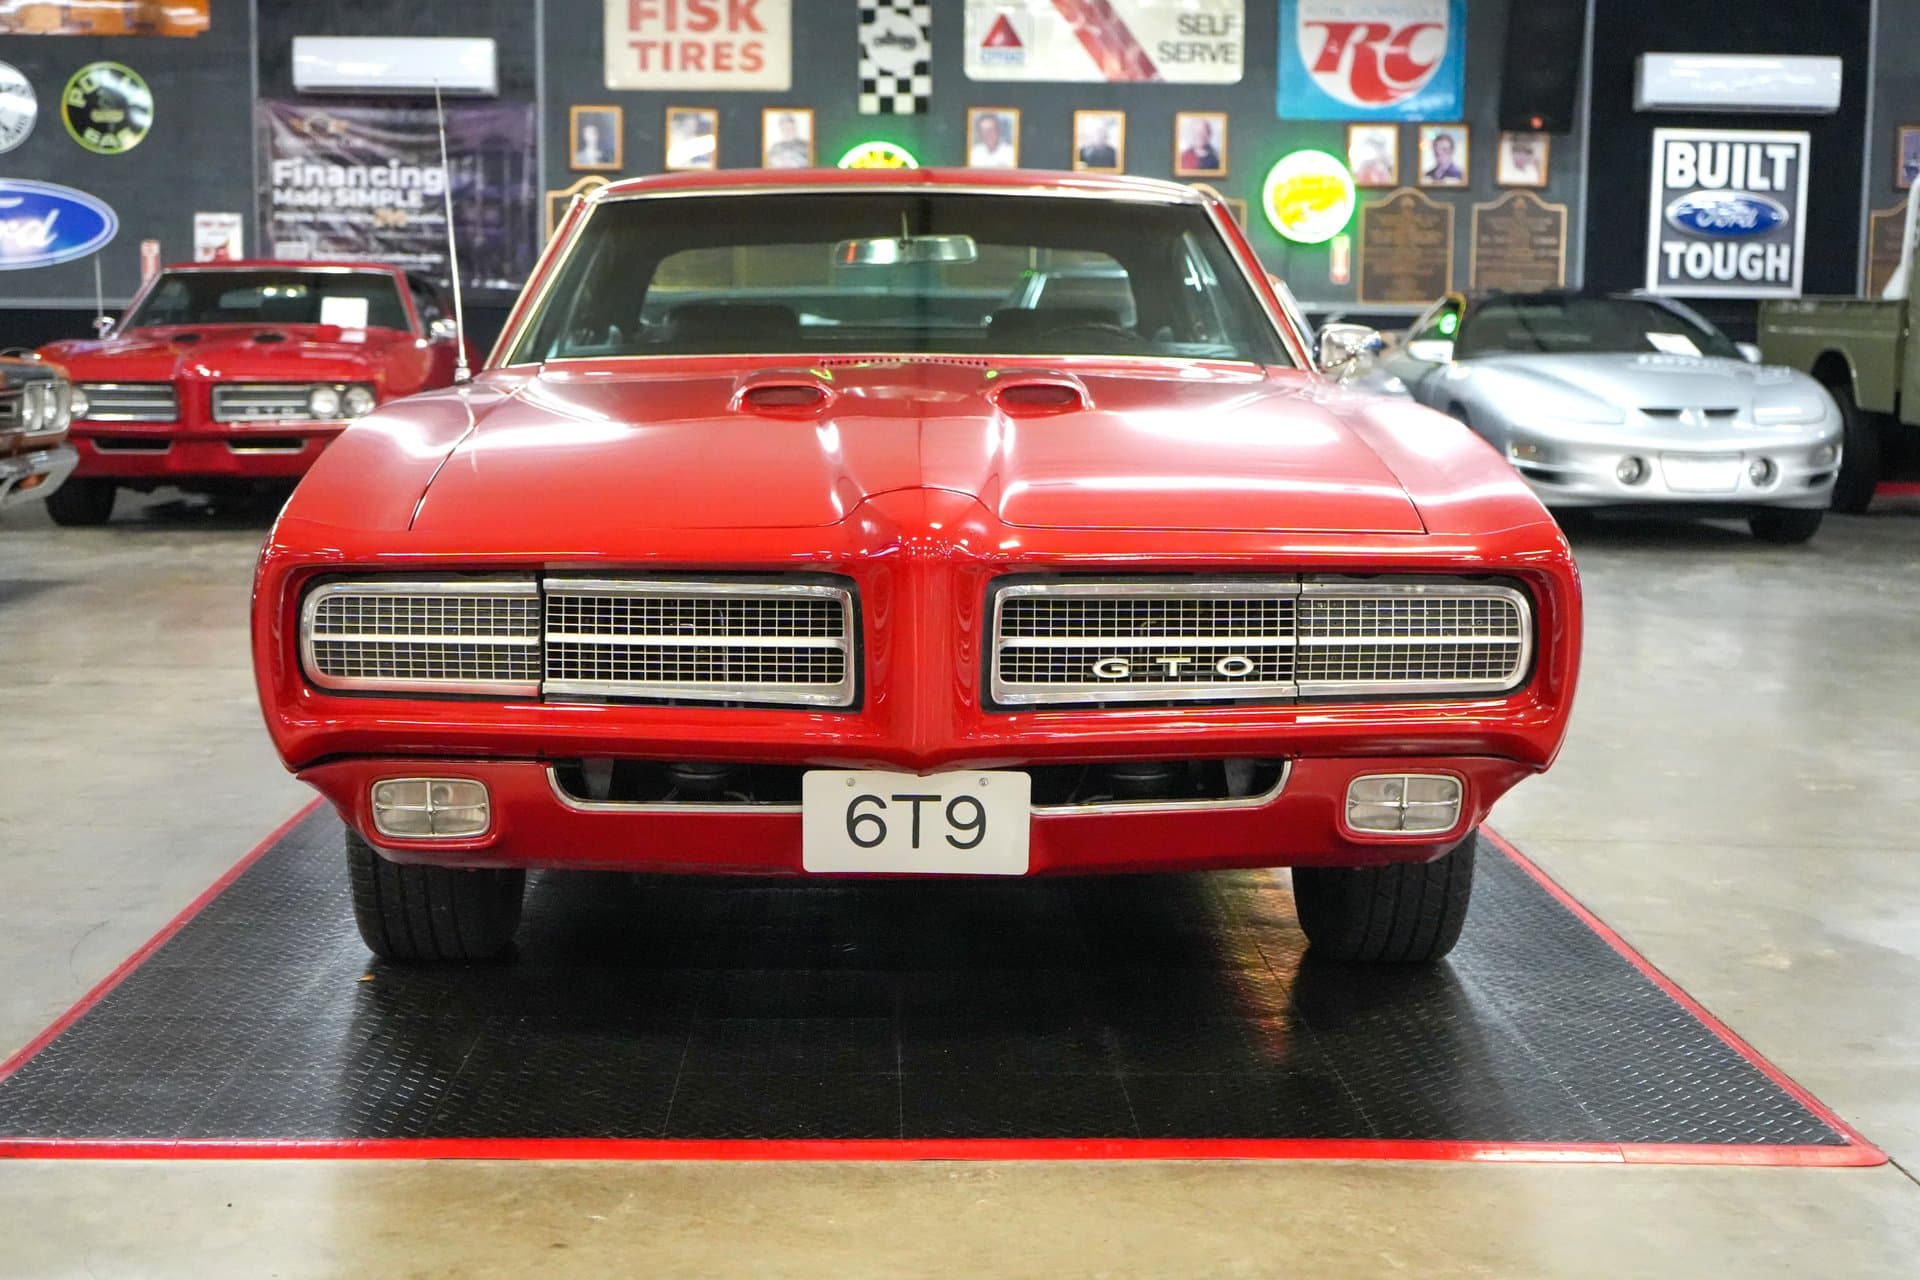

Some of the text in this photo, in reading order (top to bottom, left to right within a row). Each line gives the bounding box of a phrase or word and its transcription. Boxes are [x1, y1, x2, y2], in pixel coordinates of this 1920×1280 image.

[627, 0, 766, 33] FISK
[1177, 14, 1237, 36] SELF
[629, 42, 765, 72] TIRES
[1157, 41, 1237, 64] SERVE
[1304, 22, 1443, 103] RC
[273, 157, 445, 194] Financing
[1666, 142, 1796, 191] BUILT
[273, 188, 424, 208] Made SIMPLE
[1662, 242, 1791, 282] TOUGH
[1092, 656, 1256, 678] GTO
[846, 795, 987, 849] 6T9
